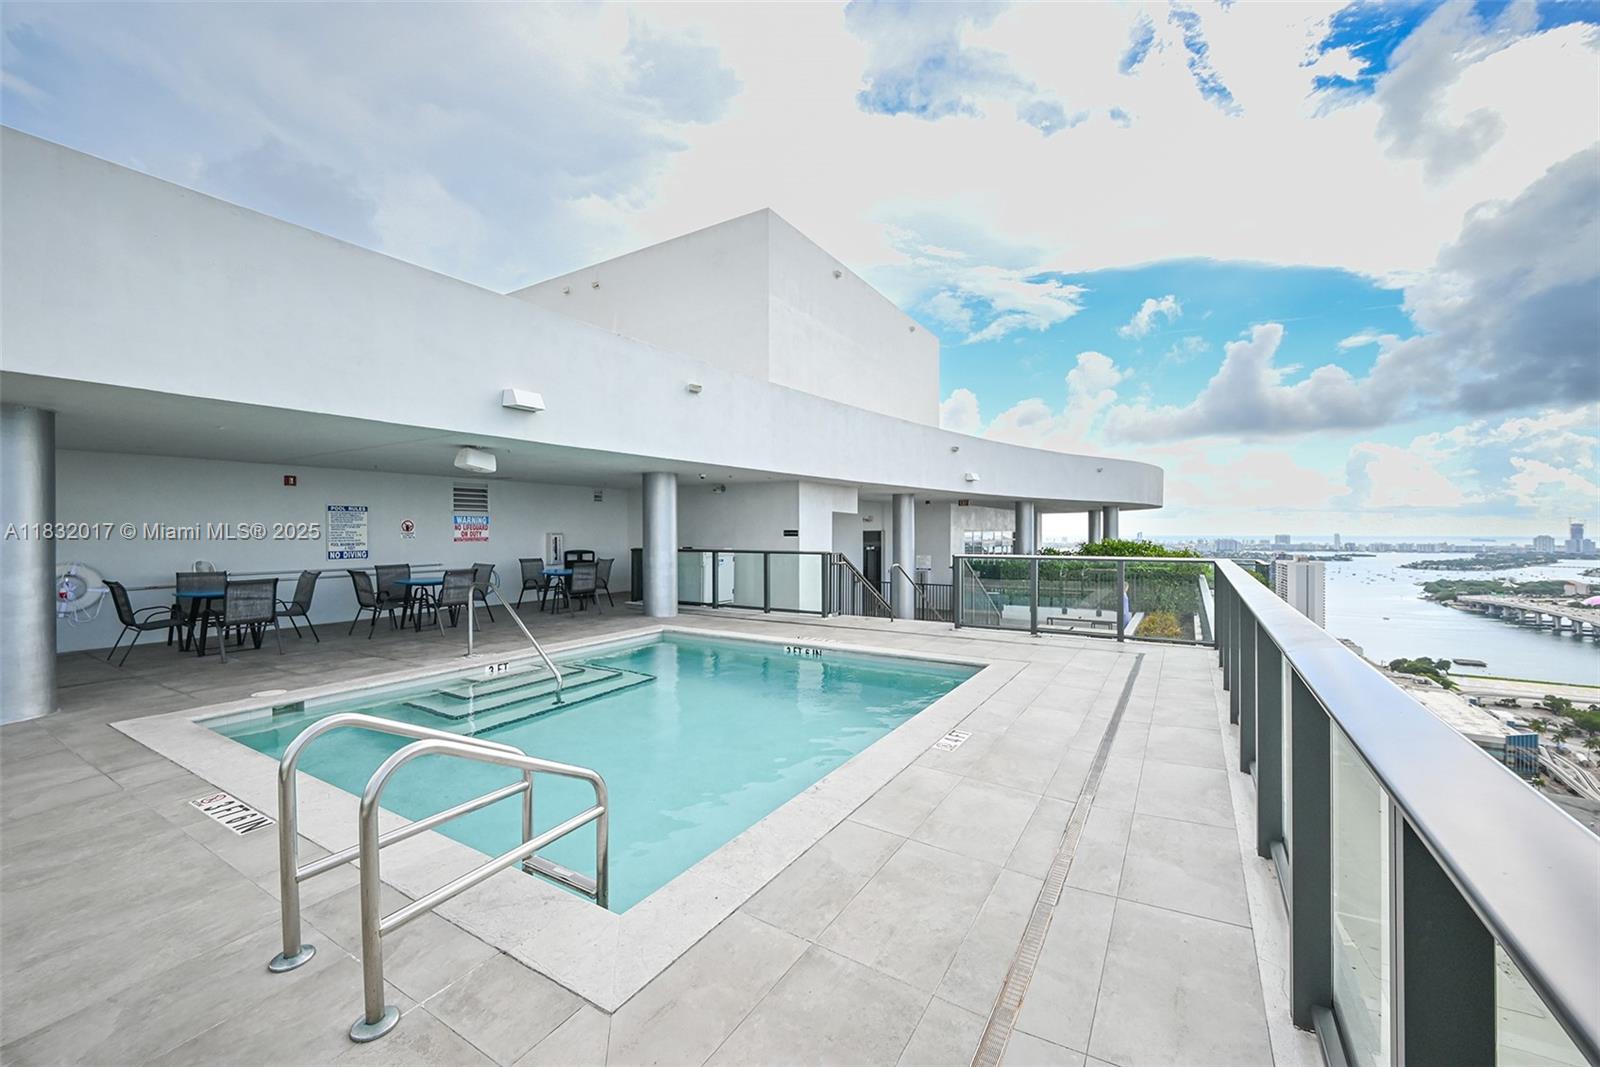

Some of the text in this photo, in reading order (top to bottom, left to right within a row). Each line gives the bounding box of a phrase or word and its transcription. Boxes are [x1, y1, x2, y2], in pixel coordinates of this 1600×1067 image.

[456, 516, 487, 524] WARNING
[330, 550, 367, 559] NO DIVING
[812, 648, 822, 657] IN
[497, 662, 509, 672] FT
[203, 800, 235, 812] 3
[210, 804, 250, 820] FT
[225, 813, 258, 825] 6
[232, 816, 273, 835] IN
